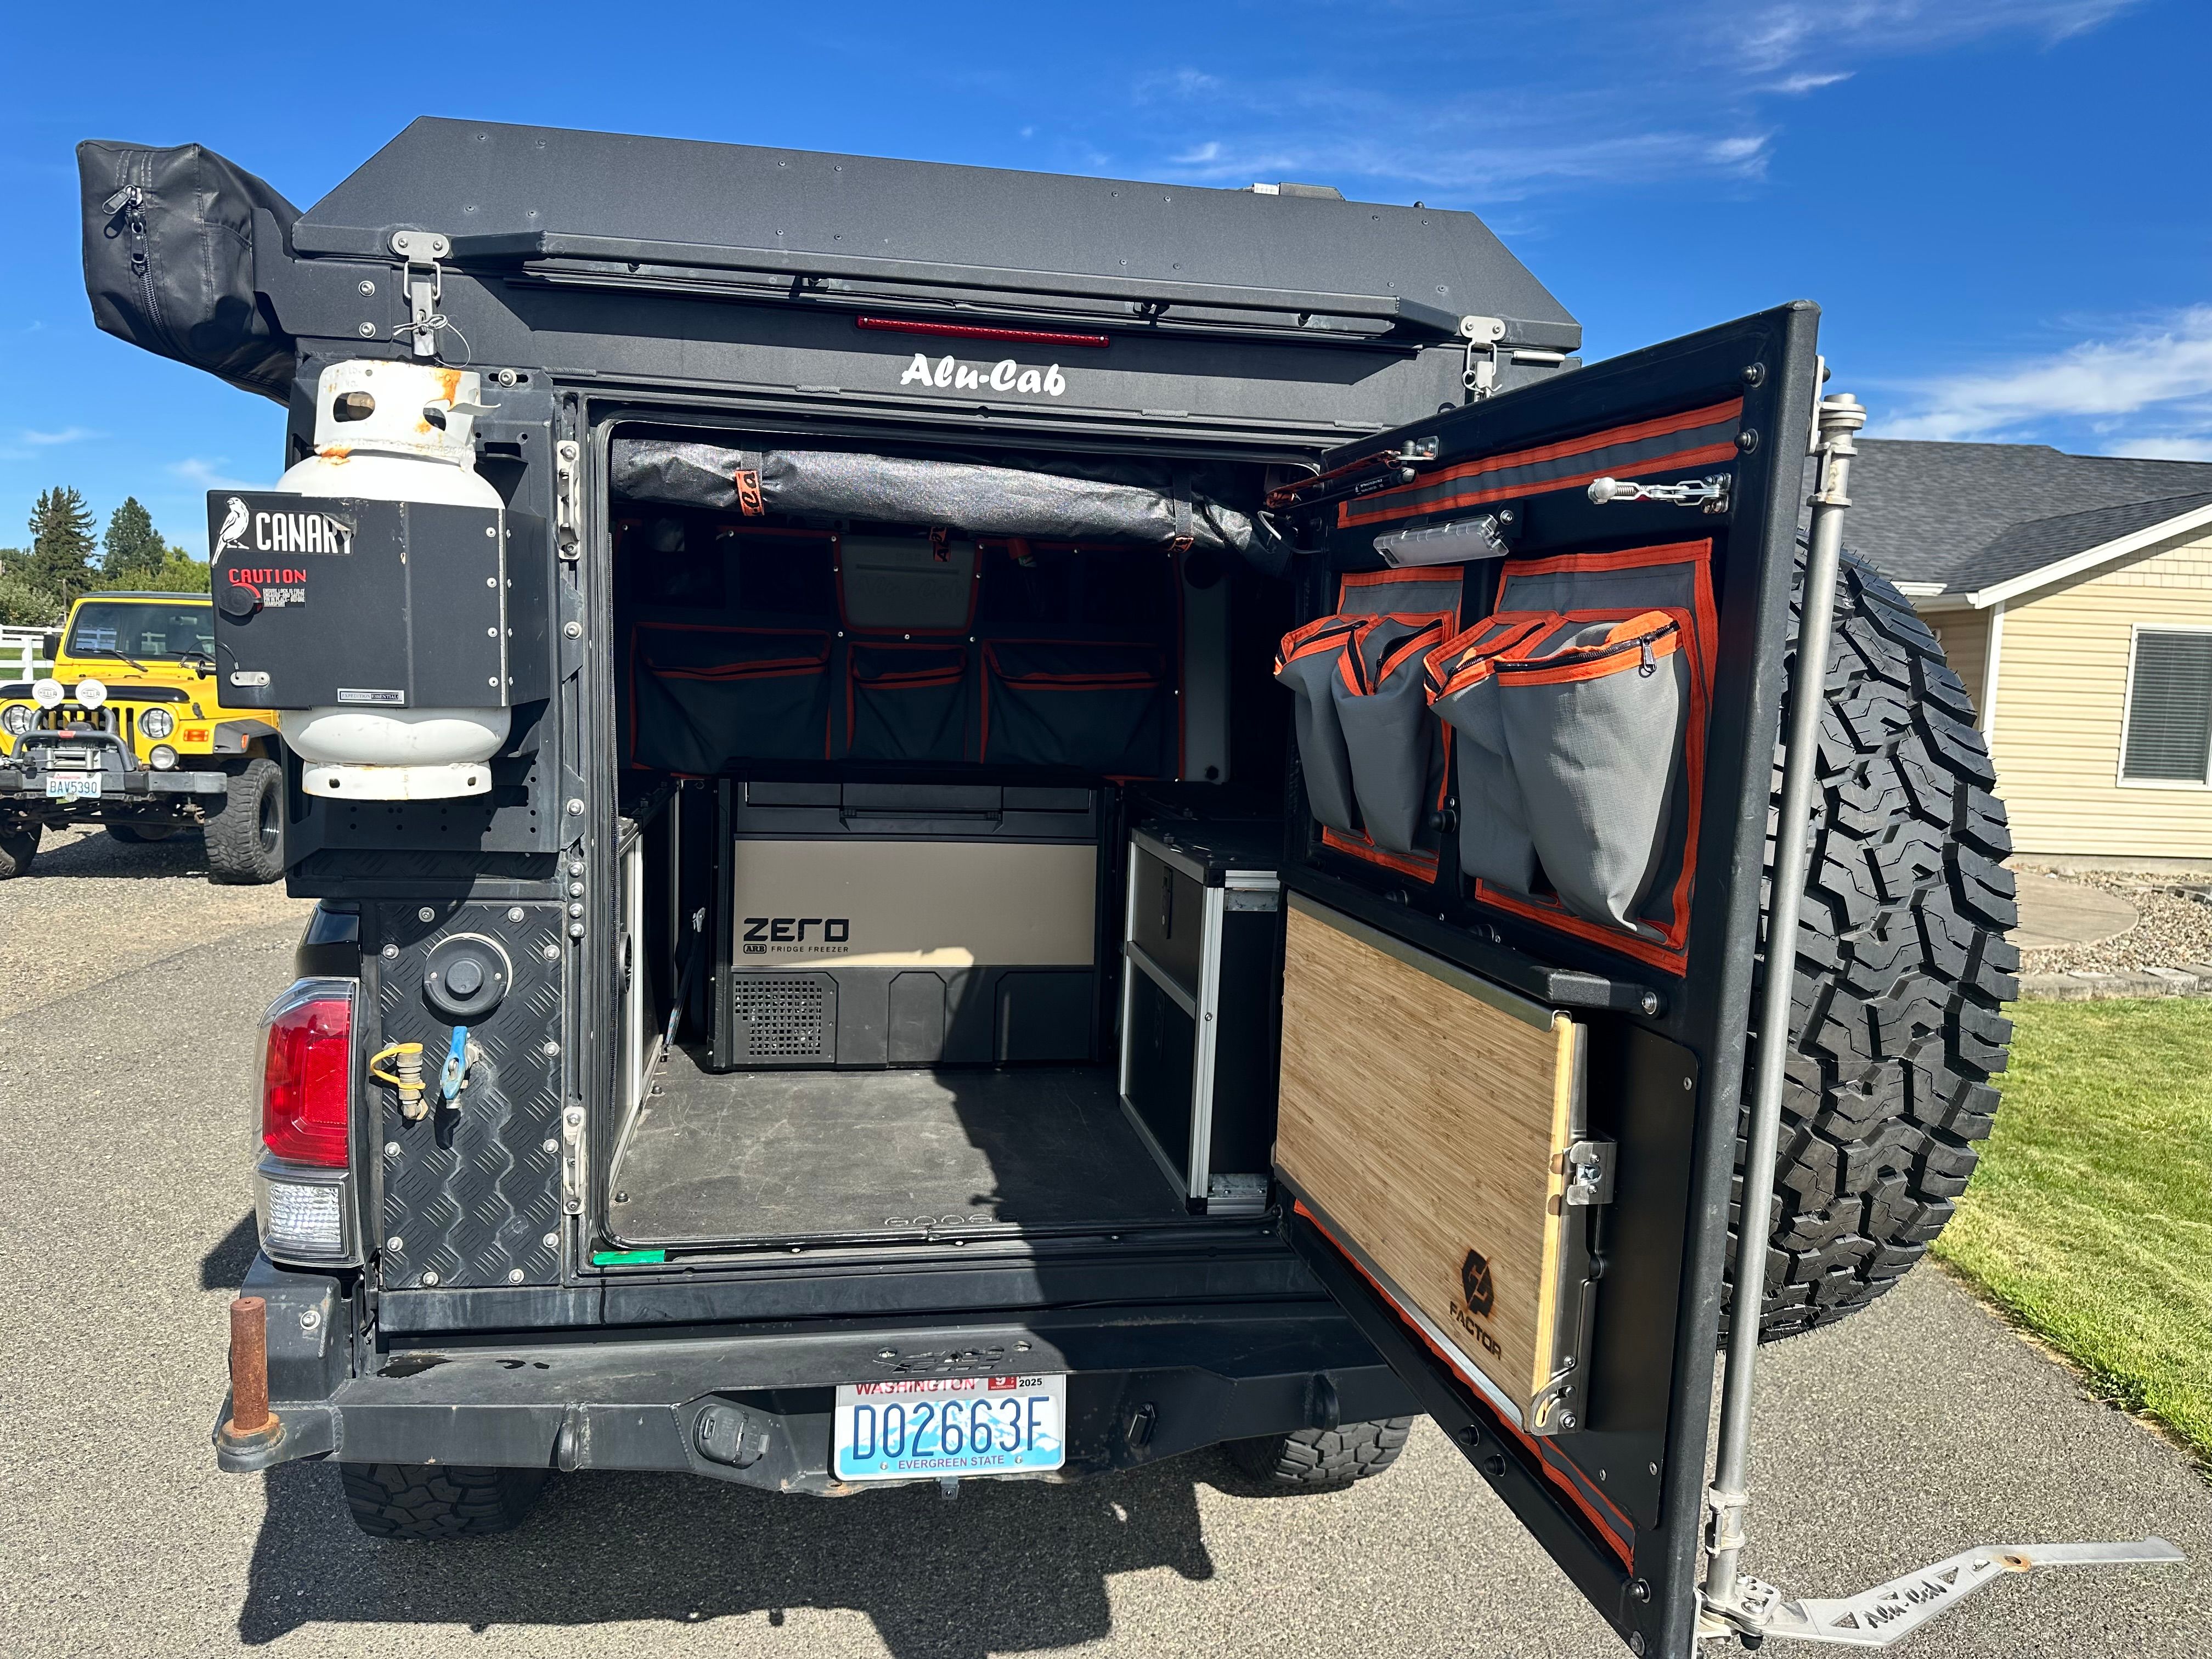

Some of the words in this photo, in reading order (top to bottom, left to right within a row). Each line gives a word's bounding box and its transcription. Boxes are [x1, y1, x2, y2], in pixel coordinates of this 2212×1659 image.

[900, 353, 1066, 396] Alu-Cab
[256, 512, 351, 554] CANARY
[228, 568, 307, 584] CAUTION
[50, 781, 97, 793] BAV5390
[1449, 1301, 1502, 1361] FACTOR
[856, 1378, 975, 1395] WASHINGTON
[1019, 1378, 1042, 1387] 2025
[853, 1396, 1049, 1460] D02663F
[899, 1458, 967, 1470] EVERGREEN
[970, 1455, 1005, 1466] STATE
[1860, 1579, 1948, 1629] Alu-Cab
